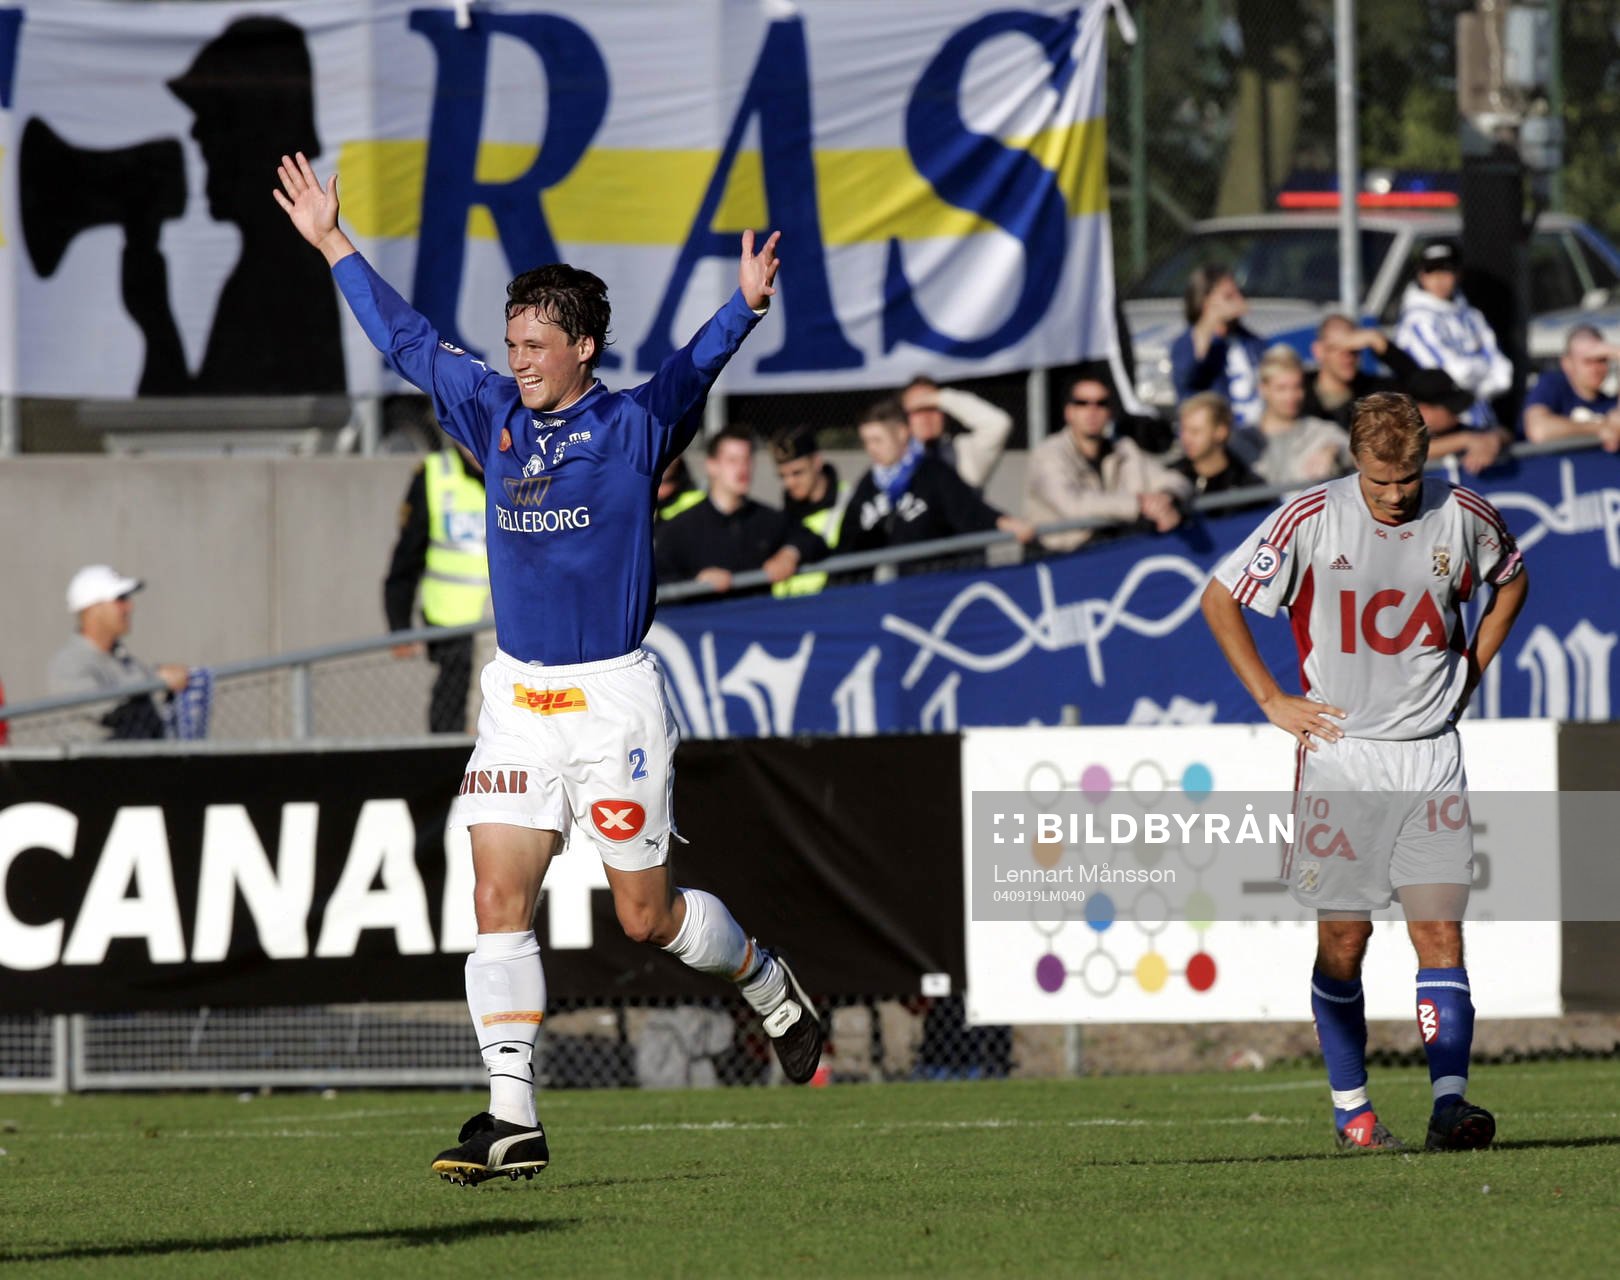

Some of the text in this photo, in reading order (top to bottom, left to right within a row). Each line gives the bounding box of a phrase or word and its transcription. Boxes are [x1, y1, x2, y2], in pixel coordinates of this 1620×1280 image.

[384, 8, 1078, 374] RAS
[1252, 552, 1274, 571] 13
[1339, 588, 1450, 656] ICA
[526, 691, 573, 711] DHL
[628, 748, 649, 782] 2
[1304, 796, 1330, 819] 10
[1297, 822, 1358, 861] ICA
[1418, 1003, 1437, 1043] AXA
